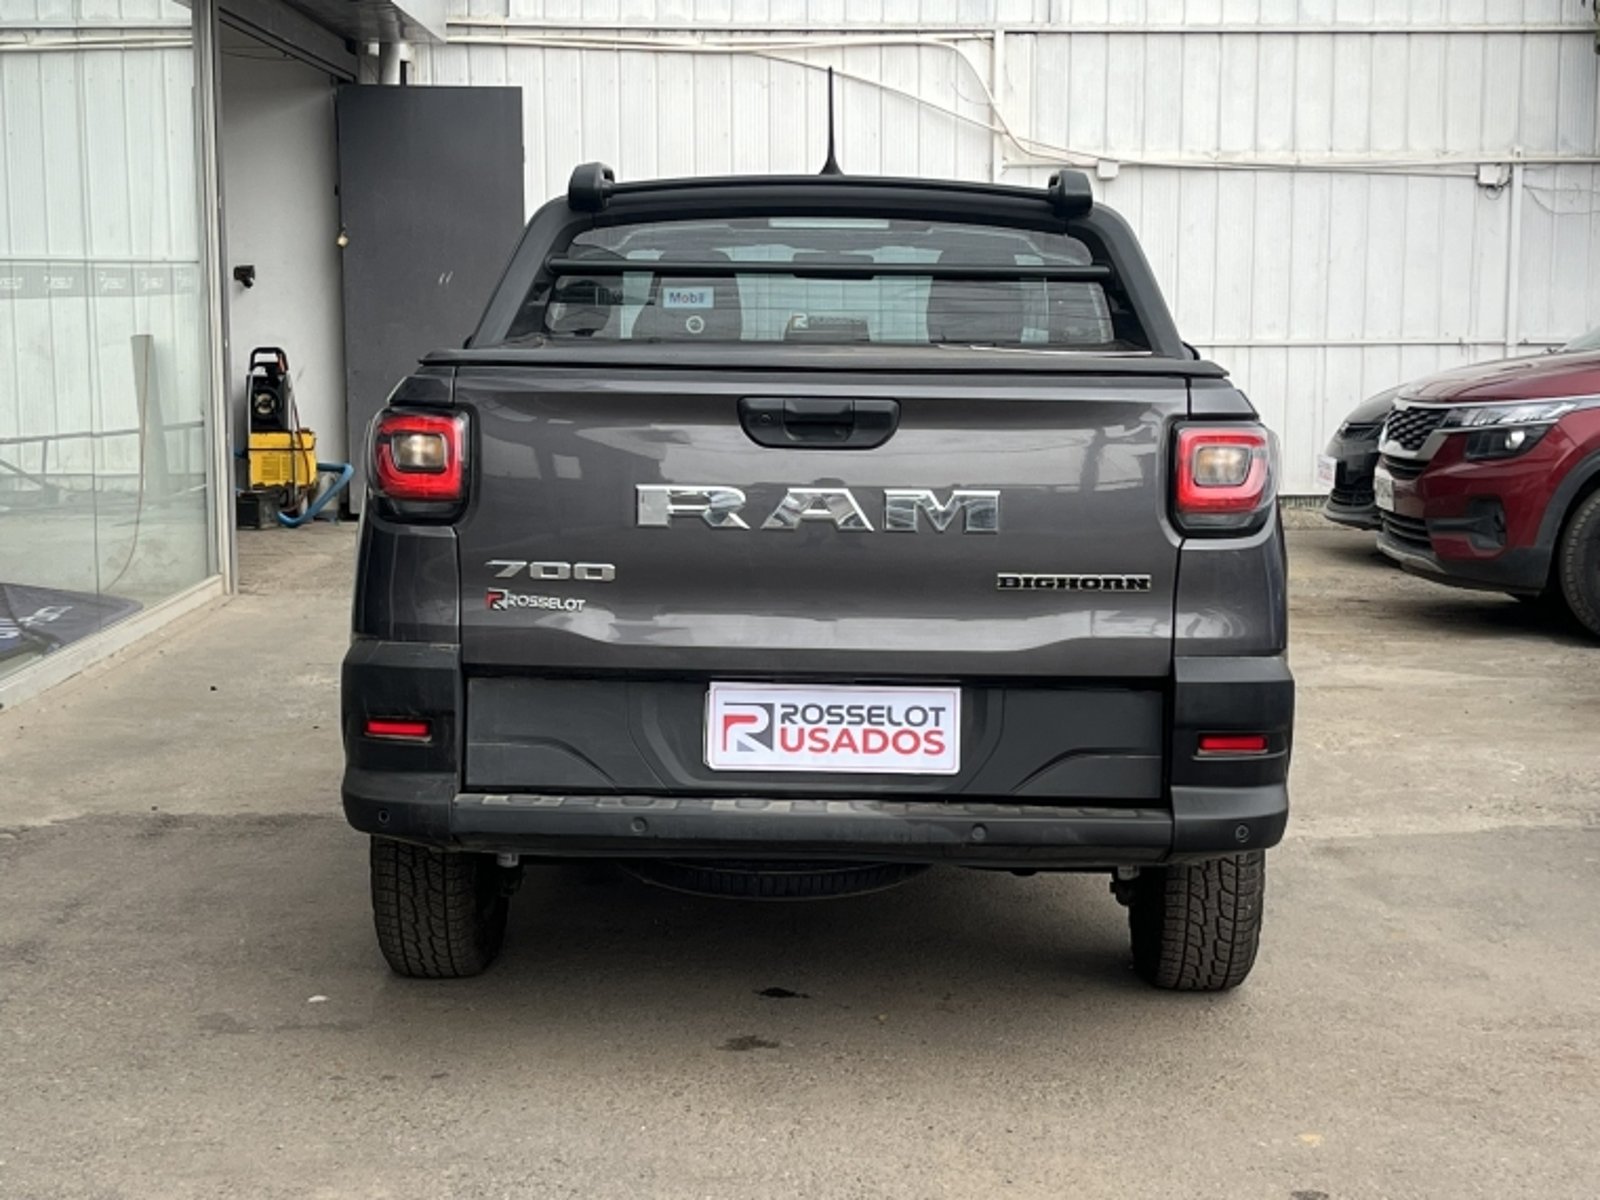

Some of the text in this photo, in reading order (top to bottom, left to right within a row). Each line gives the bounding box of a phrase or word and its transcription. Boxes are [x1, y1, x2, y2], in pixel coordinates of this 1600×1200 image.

[668, 292, 705, 304] Mobil
[635, 484, 1001, 533] RAM
[484, 560, 616, 581] 700
[997, 574, 1152, 592] BIGHORN
[509, 594, 586, 611] ROSSELOT
[780, 703, 946, 728] ROSSELOT
[780, 726, 946, 756] USADOS
